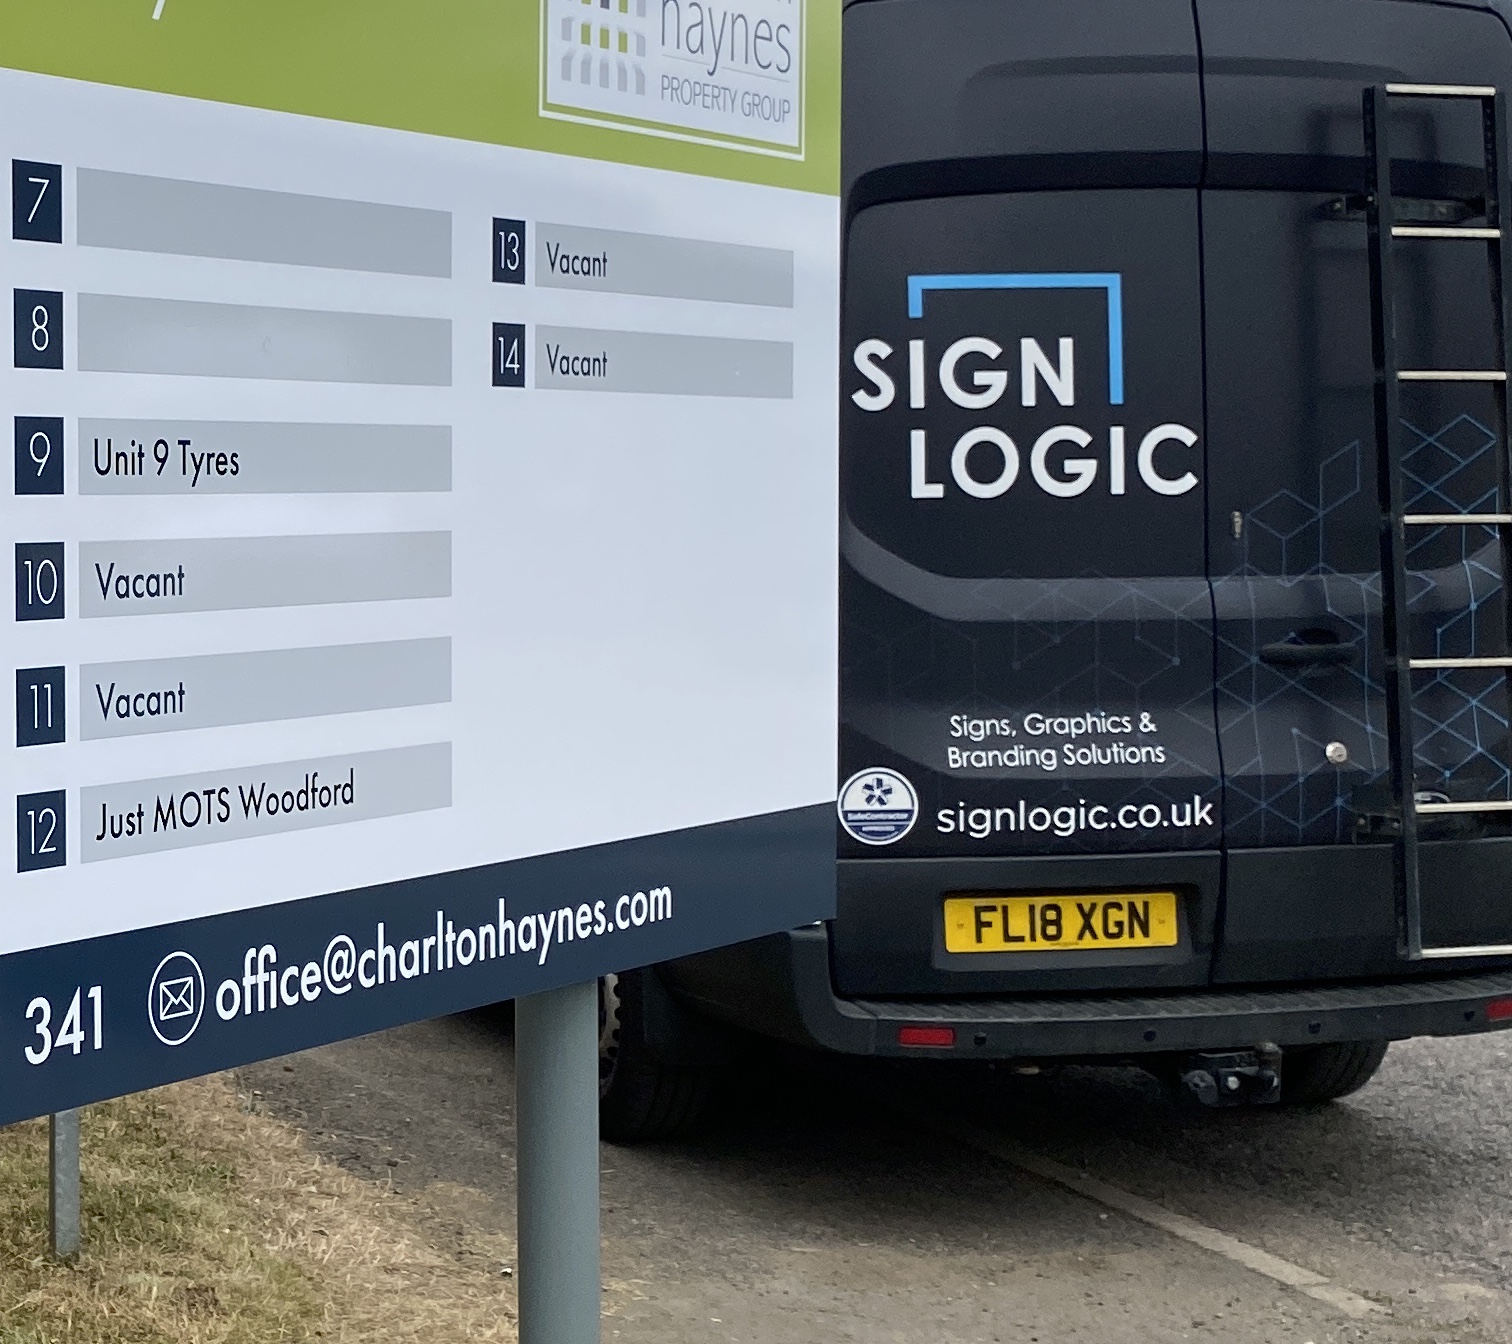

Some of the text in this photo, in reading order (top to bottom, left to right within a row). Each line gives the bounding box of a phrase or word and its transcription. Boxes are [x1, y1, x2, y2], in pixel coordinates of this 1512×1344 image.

[661, 74, 791, 123] PROPERTY GROUP
[28, 177, 50, 223] 7
[499, 231, 519, 270] 13
[546, 241, 608, 278] Vacant
[31, 305, 49, 351] 8
[498, 337, 520, 375] 14
[546, 343, 608, 378] Vacant
[851, 336, 1074, 411] SIGN
[29, 432, 50, 477] 9
[94, 438, 239, 487] Unit 9 Tyres
[911, 424, 1198, 499] LOGIC
[24, 559, 58, 605] 10
[95, 563, 184, 600] Vacant
[29, 684, 52, 729] 11
[95, 682, 185, 721] Vacant
[950, 712, 1157, 742] Signs, Graphics &
[948, 742, 1165, 771] Branding Solutions
[95, 768, 354, 841] Just MOTS Woodford
[938, 795, 1214, 838] signlogic.co.uk
[27, 807, 57, 855] 12
[974, 901, 1150, 943] FL18 XGN
[215, 885, 673, 1021] office@charltonhaynes.com
[25, 986, 102, 1066] 341
